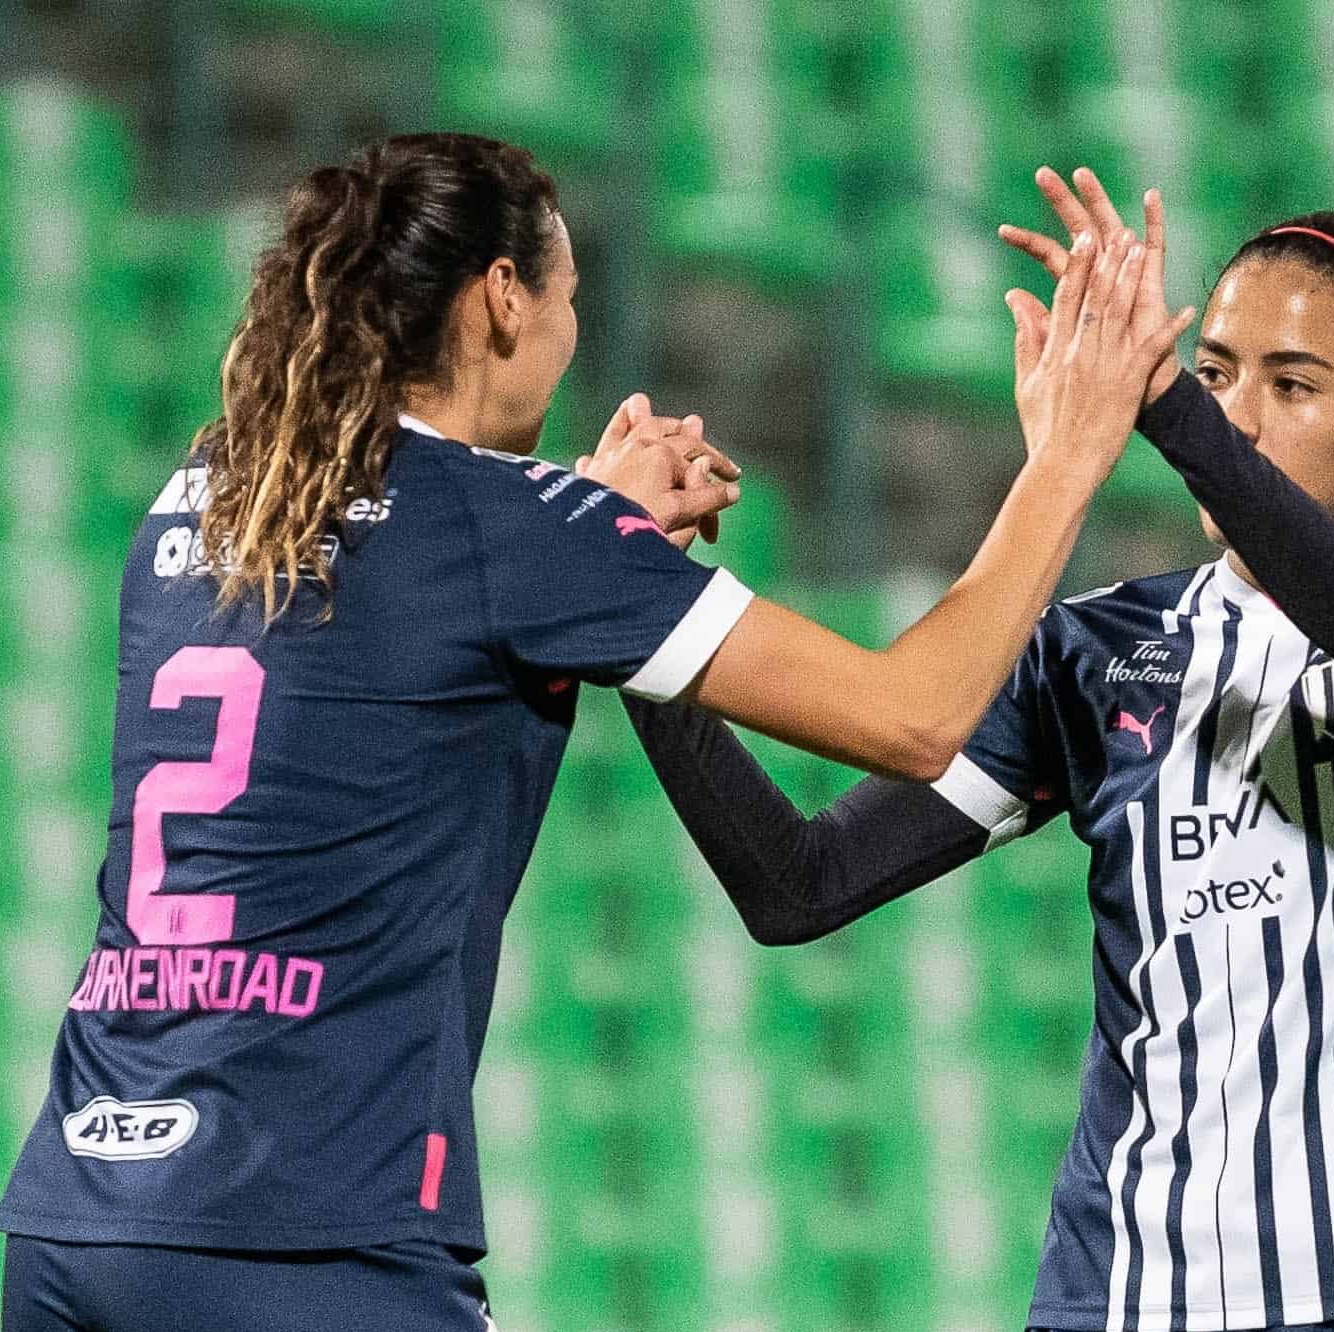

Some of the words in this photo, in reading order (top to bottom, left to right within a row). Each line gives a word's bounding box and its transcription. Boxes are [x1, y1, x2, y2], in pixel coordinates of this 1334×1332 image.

[1132, 640, 1171, 660] Tim
[1105, 656, 1182, 683] Hortons
[125, 645, 267, 946] 2
[1179, 875, 1276, 924] otex
